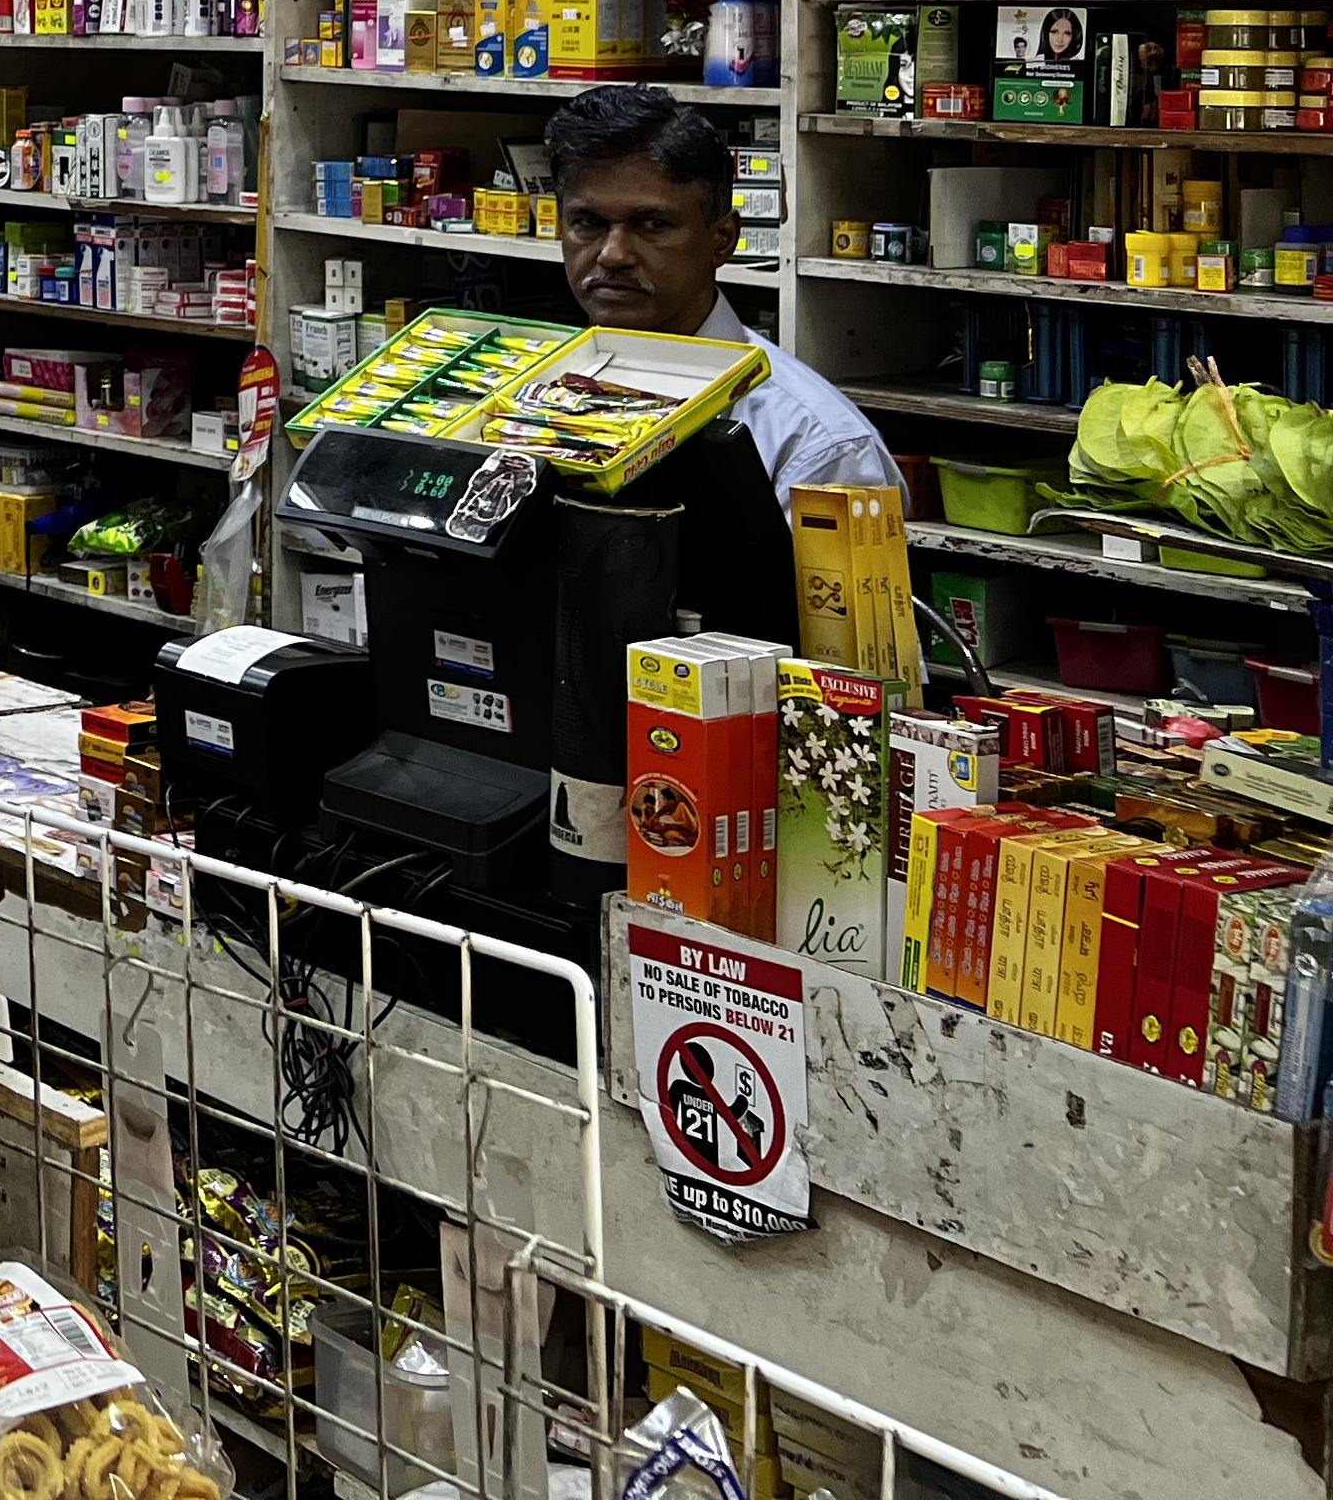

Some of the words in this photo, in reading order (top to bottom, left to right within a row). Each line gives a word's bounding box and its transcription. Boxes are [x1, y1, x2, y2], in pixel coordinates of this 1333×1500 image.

[650, 435, 676, 460] Raju
[422, 471, 453, 487] 5.00
[623, 455, 649, 483] Gold
[315, 584, 353, 598] Energizer
[820, 675, 877, 700] EXCLUSIVE
[798, 897, 869, 956] lia
[680, 945, 701, 969] BY
[708, 953, 746, 981] LAW
[643, 962, 662, 982] NO
[667, 969, 699, 993] SALE
[704, 980, 721, 999] OF
[724, 986, 788, 1019] TOBACCO
[638, 982, 655, 1001] TO
[659, 989, 721, 1020] PERSONS
[725, 1008, 773, 1036] BELOW
[779, 1024, 795, 1043] 21
[739, 1070, 752, 1097] $
[683, 1093, 714, 1114] UNDER
[686, 1109, 713, 1143] 21
[683, 1185, 708, 1209] up
[712, 1190, 728, 1213] to
